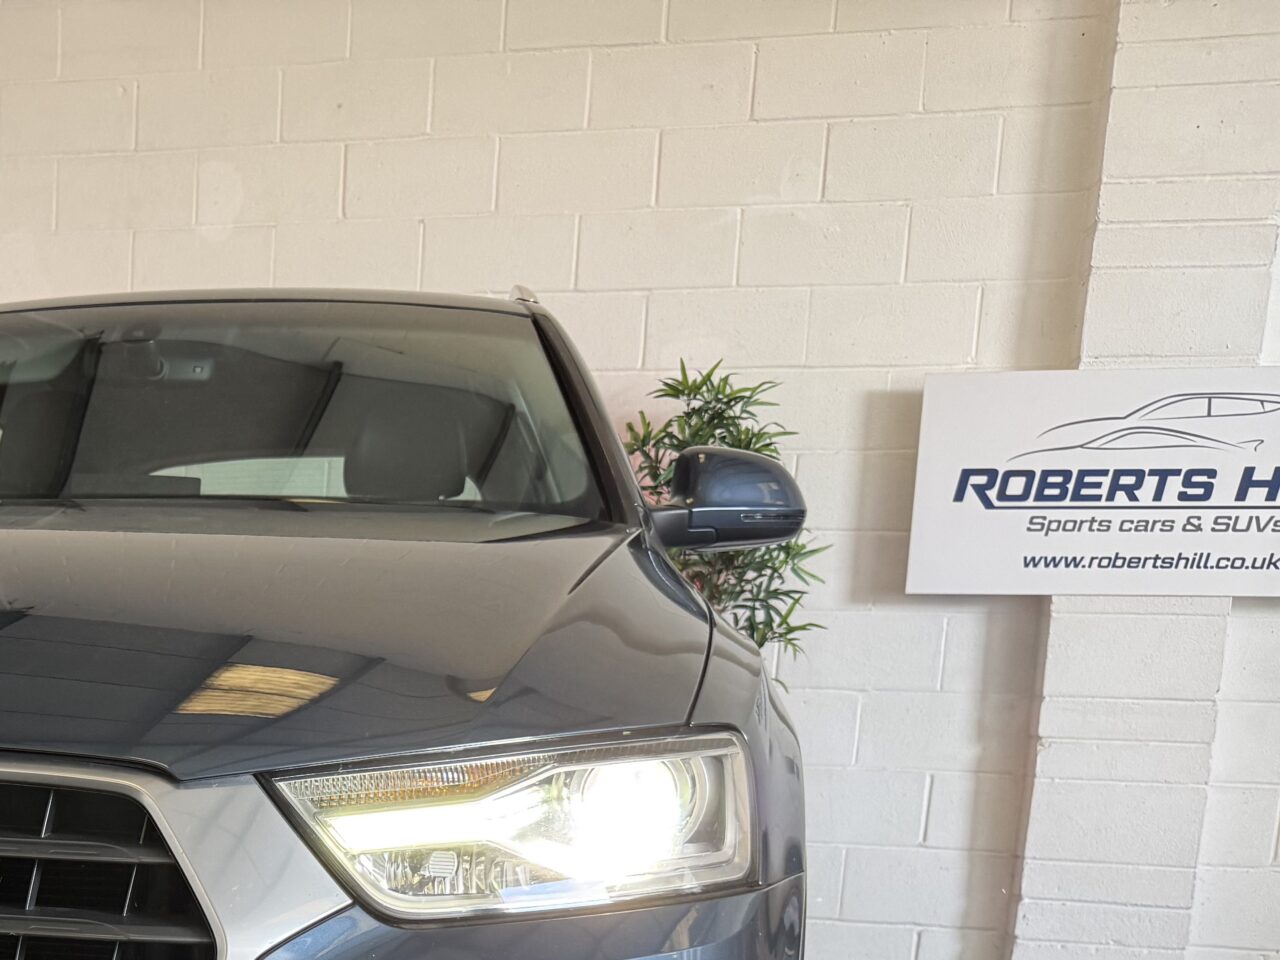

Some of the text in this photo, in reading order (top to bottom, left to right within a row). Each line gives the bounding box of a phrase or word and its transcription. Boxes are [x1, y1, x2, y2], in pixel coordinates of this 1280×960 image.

[952, 468, 1218, 510] ROBERTS
[1026, 515, 1112, 536] Sports
[1118, 519, 1175, 533] cars
[1181, 515, 1203, 532] &
[1023, 552, 1280, 570] www.robertshill.co.uk
